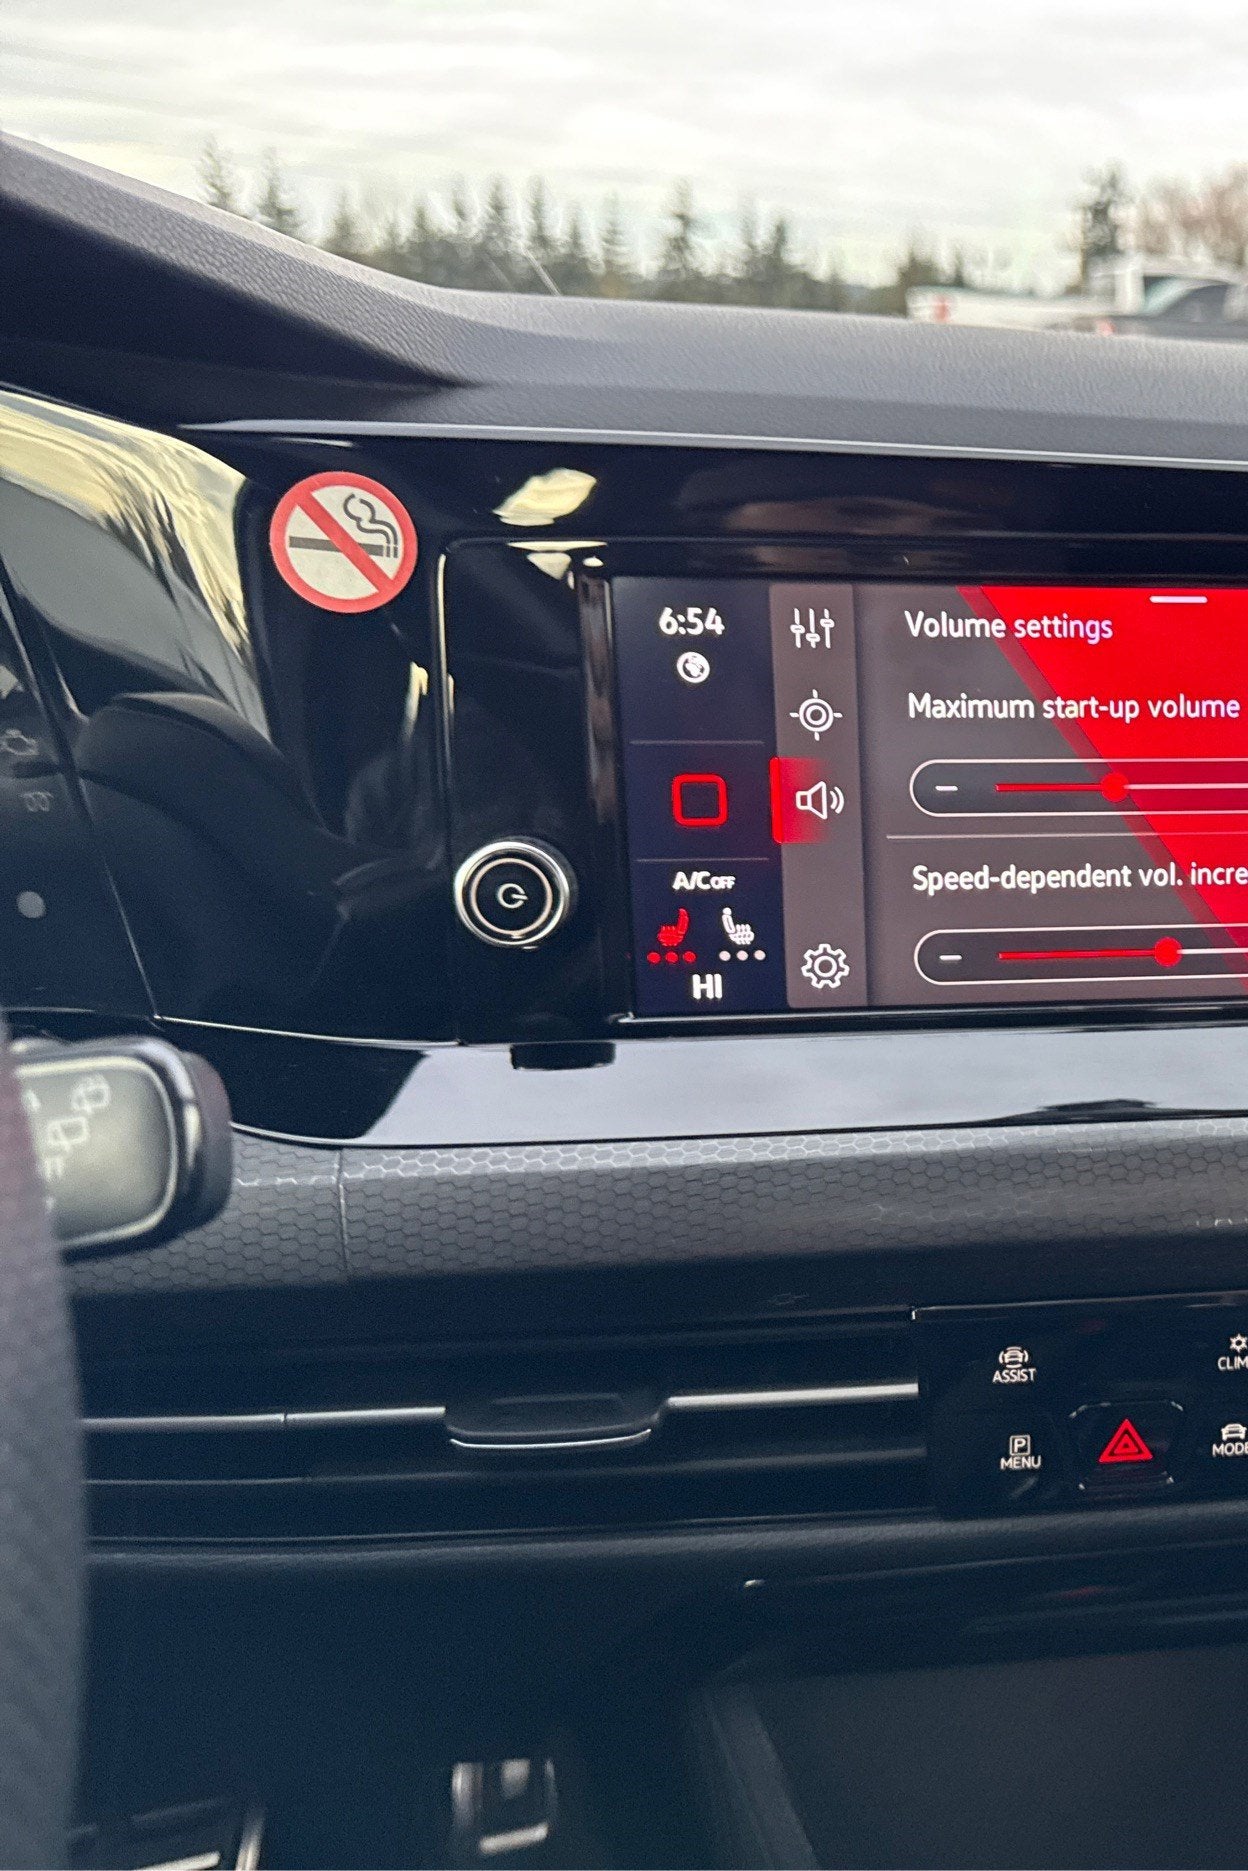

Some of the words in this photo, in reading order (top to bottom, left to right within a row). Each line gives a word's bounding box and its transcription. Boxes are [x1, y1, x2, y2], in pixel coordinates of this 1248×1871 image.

[658, 606, 726, 636] 6:54
[904, 610, 1006, 638] Volume
[1014, 613, 1113, 645] settings
[908, 692, 1035, 719] Maximum
[1042, 696, 1140, 724] start-up
[1147, 693, 1241, 719] volume
[912, 862, 1132, 897] Speed-dependent
[1138, 861, 1183, 887] vol.
[692, 973, 723, 1000] HI
[992, 1368, 1036, 1383] ASSIST
[1000, 1455, 1042, 1470] MENU
